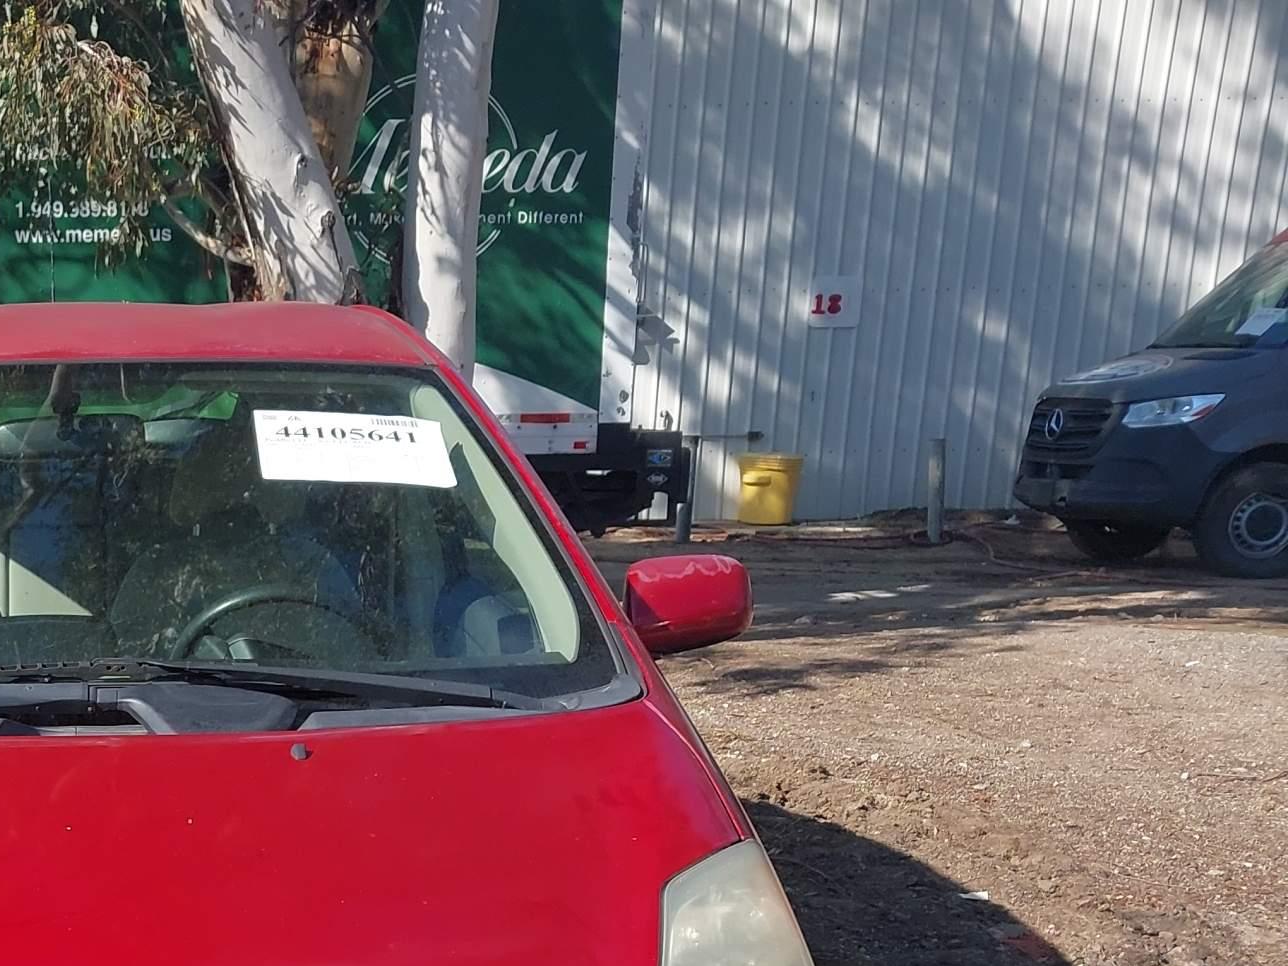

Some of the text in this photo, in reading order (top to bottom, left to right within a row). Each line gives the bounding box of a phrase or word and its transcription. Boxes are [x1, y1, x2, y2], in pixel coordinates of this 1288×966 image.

[517, 210, 584, 224] Different
[811, 293, 842, 315] 18
[275, 424, 417, 443] 44105641
